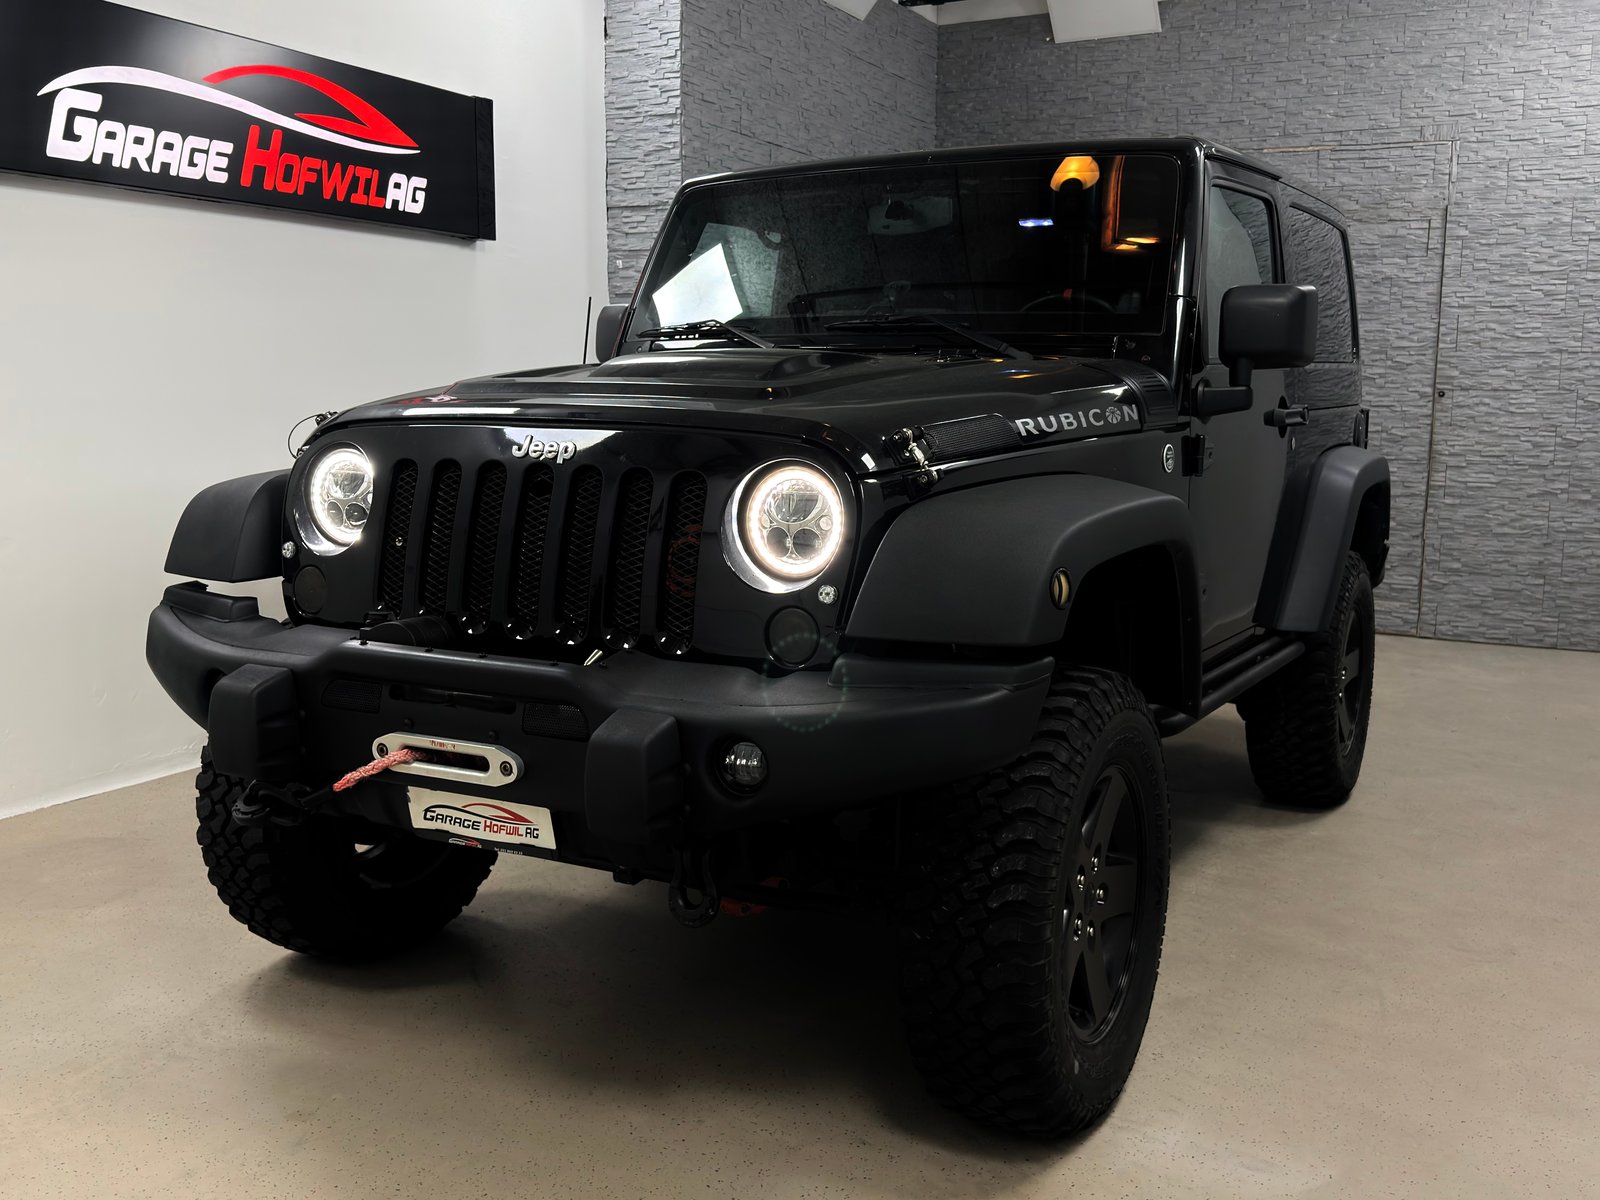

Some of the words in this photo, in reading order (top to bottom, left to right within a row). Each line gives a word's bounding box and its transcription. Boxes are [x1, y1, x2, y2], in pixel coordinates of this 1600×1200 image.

[46, 88, 234, 184] GARAGE
[1014, 404, 1139, 437] RUBICON
[511, 434, 577, 464] Jeep
[423, 809, 482, 831] GARAGE
[483, 819, 524, 837] HOFWIL
[524, 826, 540, 839] AG
